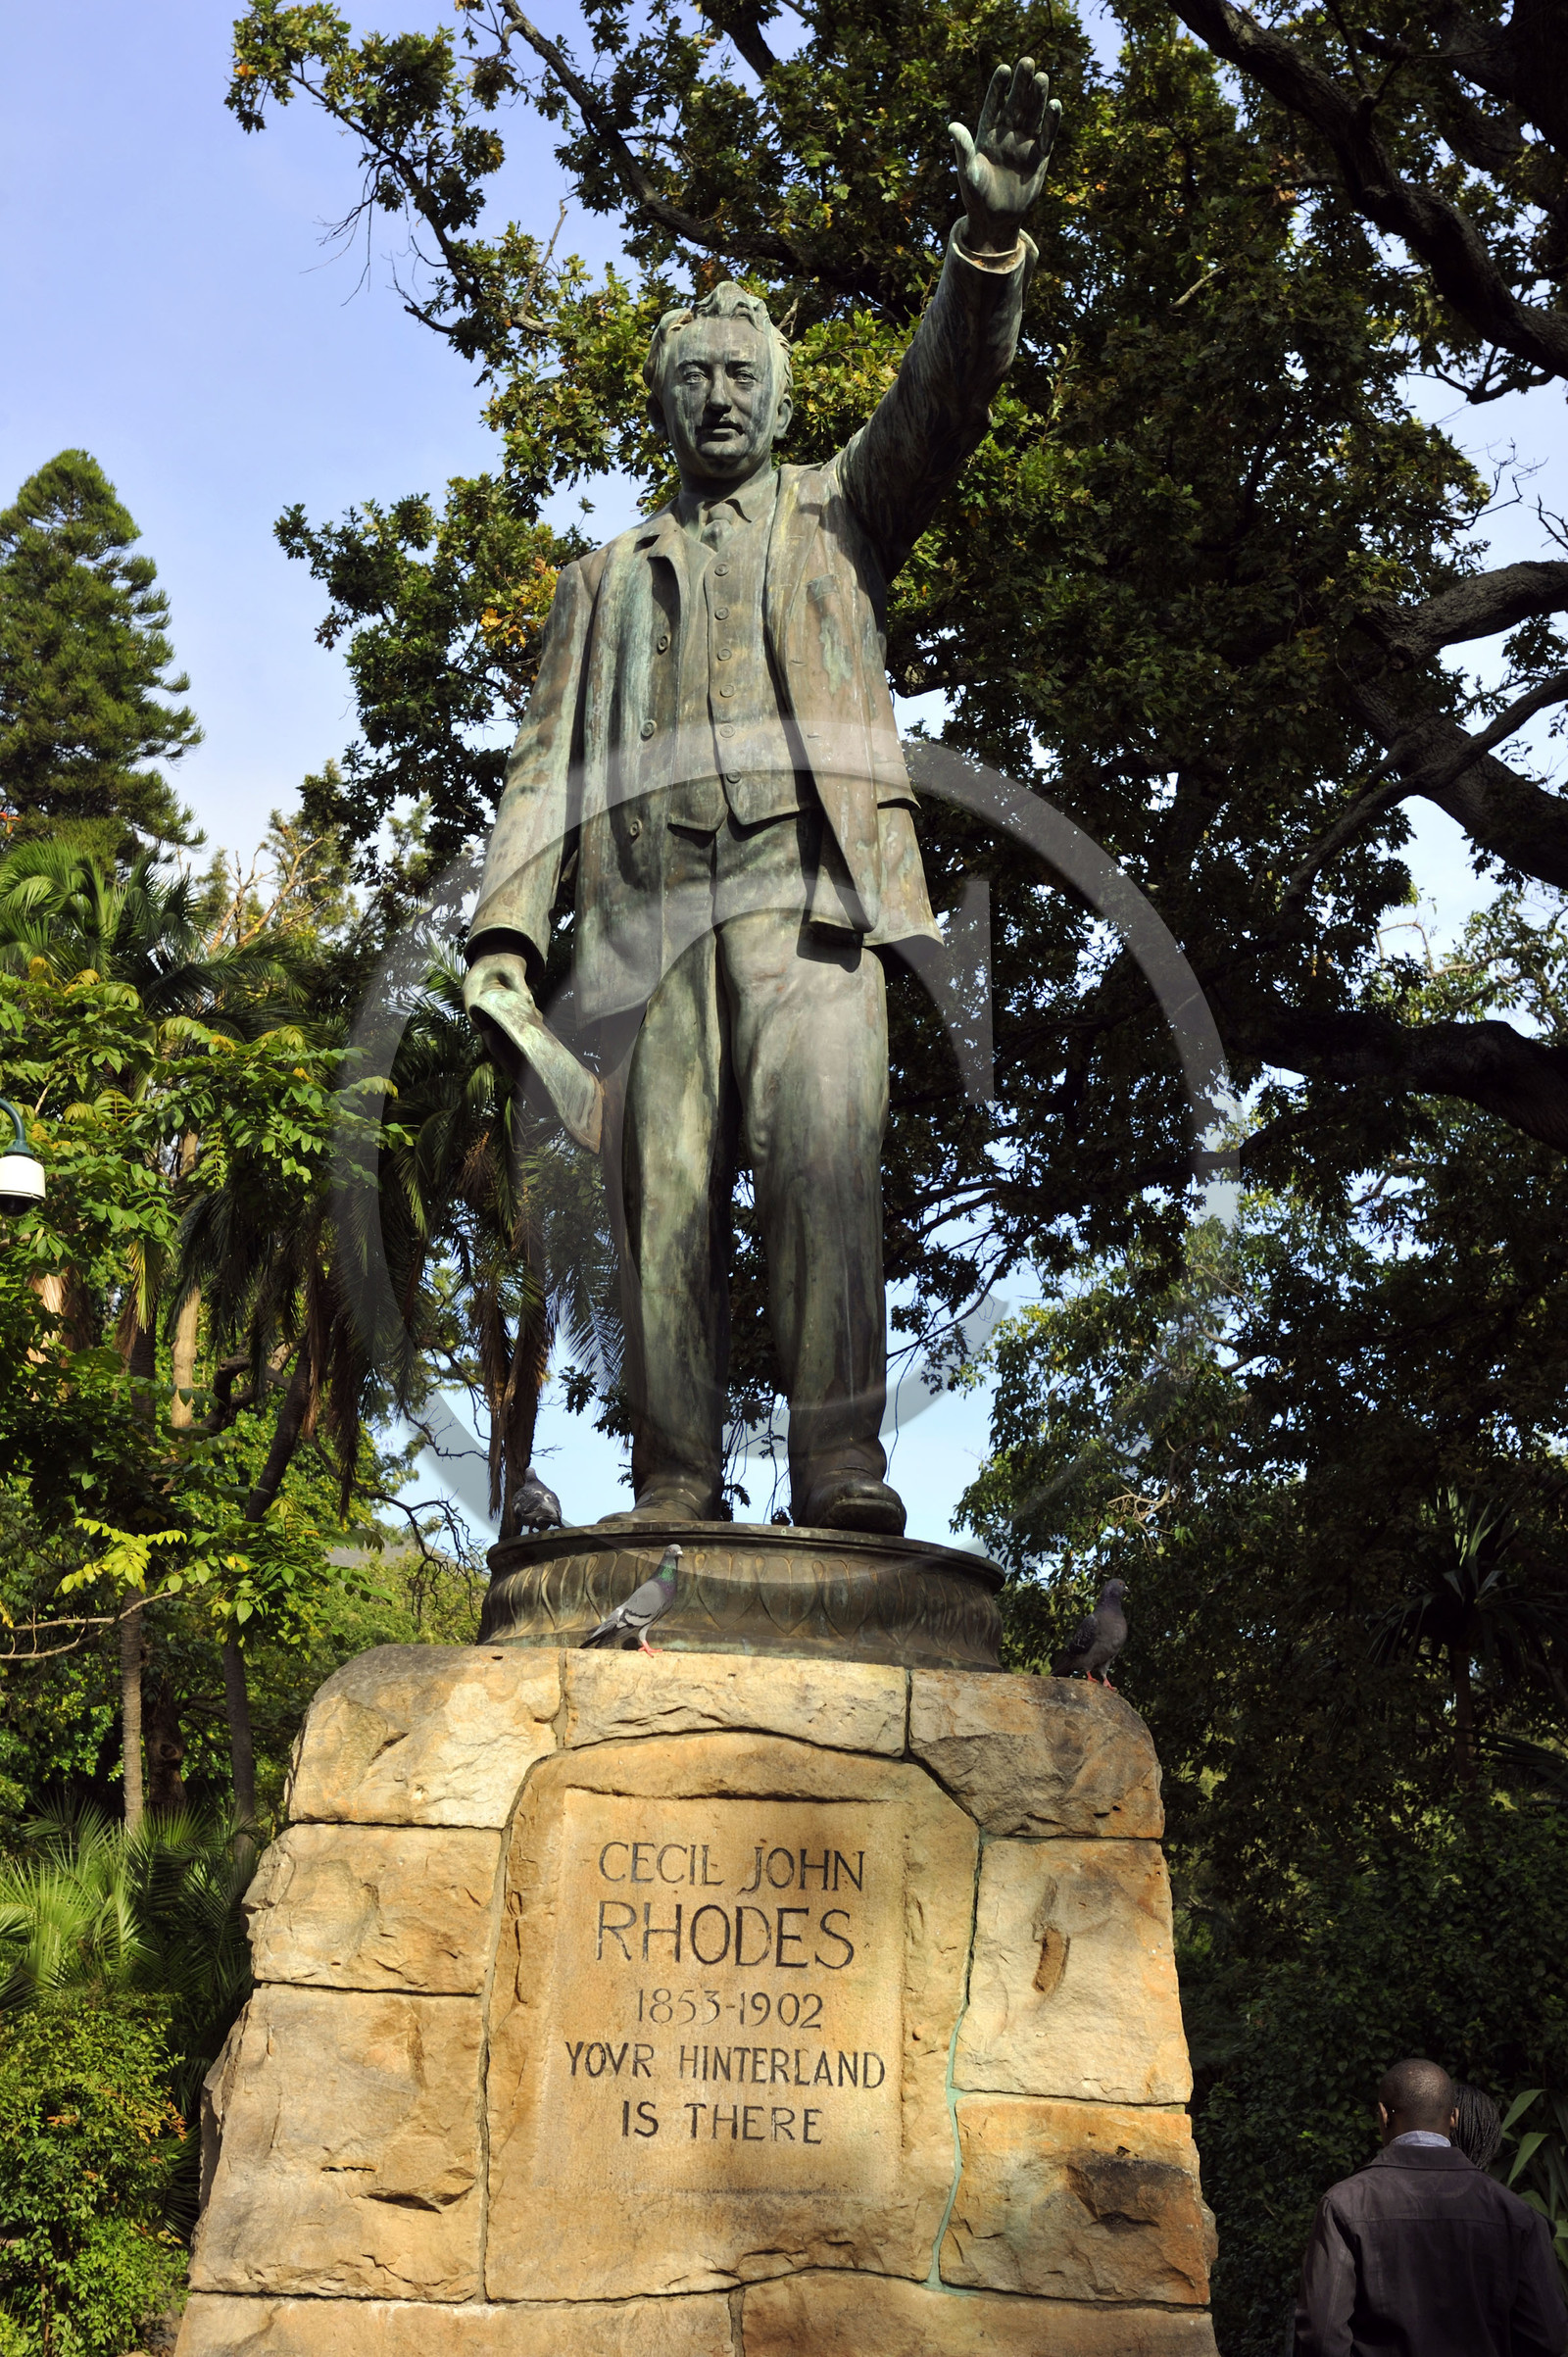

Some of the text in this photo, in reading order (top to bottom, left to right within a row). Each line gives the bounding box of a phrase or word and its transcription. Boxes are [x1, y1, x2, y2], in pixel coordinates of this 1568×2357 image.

[599, 1841, 865, 1895] CECIL JOHN
[596, 1900, 855, 1970] RHODES
[637, 1988, 824, 2030] 1853-1902
[564, 2040, 886, 2089] YOVR HINTERLAND
[621, 2100, 823, 2145] IS THERE
